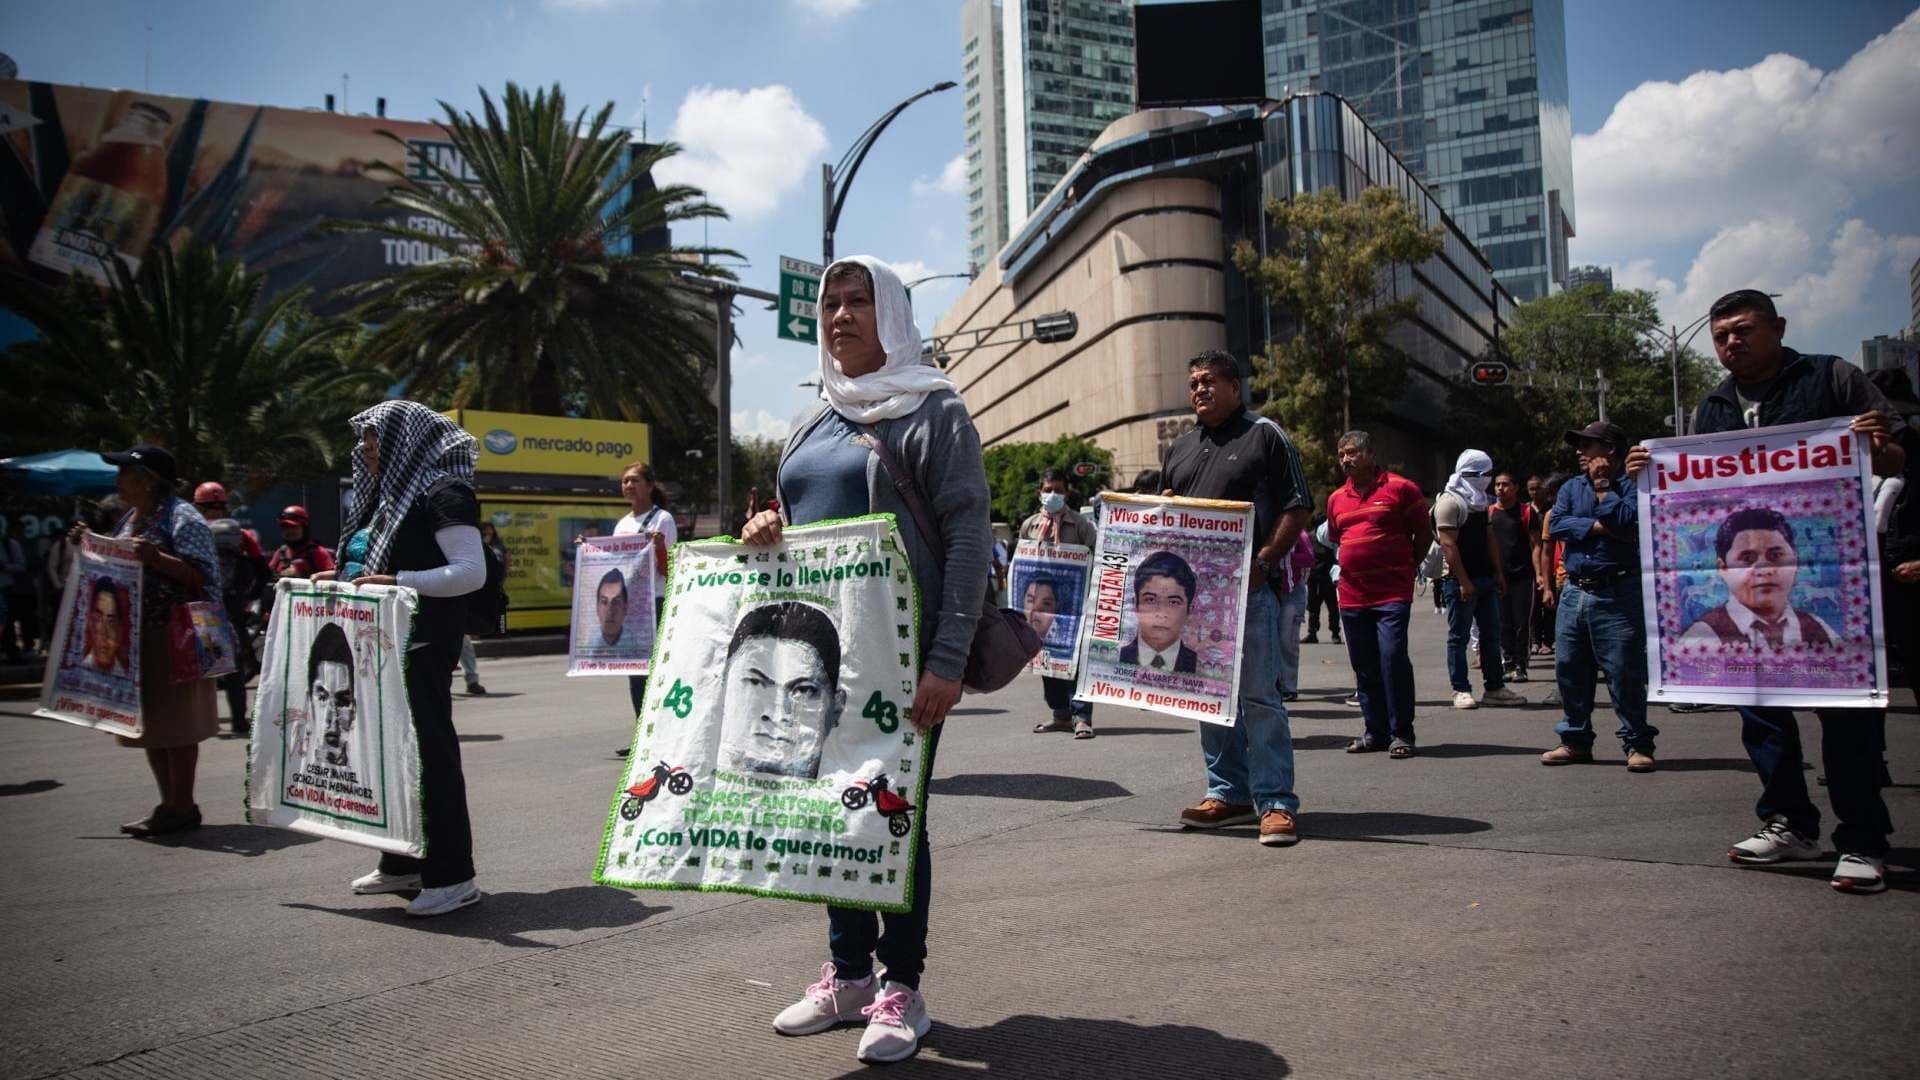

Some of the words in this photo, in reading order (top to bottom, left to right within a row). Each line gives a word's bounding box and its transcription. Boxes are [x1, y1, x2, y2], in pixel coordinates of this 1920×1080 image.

[522, 437, 593, 453] mercado
[596, 441, 633, 459] pago
[1657, 435, 1852, 491] ¡Justicia!
[1108, 508, 1139, 525] ¡Vivo
[1142, 513, 1158, 525] se
[1161, 511, 1175, 527] lo
[1179, 513, 1244, 532] llevaron!
[1047, 547, 1087, 561] llevaron!
[747, 571, 771, 586] se
[776, 567, 793, 587] lo
[798, 556, 891, 585] llevaron!
[1098, 569, 1125, 613] FALTAN
[1094, 614, 1120, 640] NOS
[1113, 667, 1137, 677] JORGE
[1182, 678, 1204, 689] NAVA
[663, 677, 693, 718] 43
[1090, 681, 1125, 697] ¡Vivo
[1129, 687, 1142, 701] lo
[1146, 693, 1222, 715] queremos!
[862, 690, 899, 734] 43
[305, 787, 326, 805] VIDA
[694, 790, 751, 807] JORGE
[759, 794, 842, 816] ANTONIO
[634, 829, 681, 848] ¡Con
[688, 829, 740, 849] VIDA
[746, 831, 767, 850] lo
[772, 838, 884, 864] queremos!
